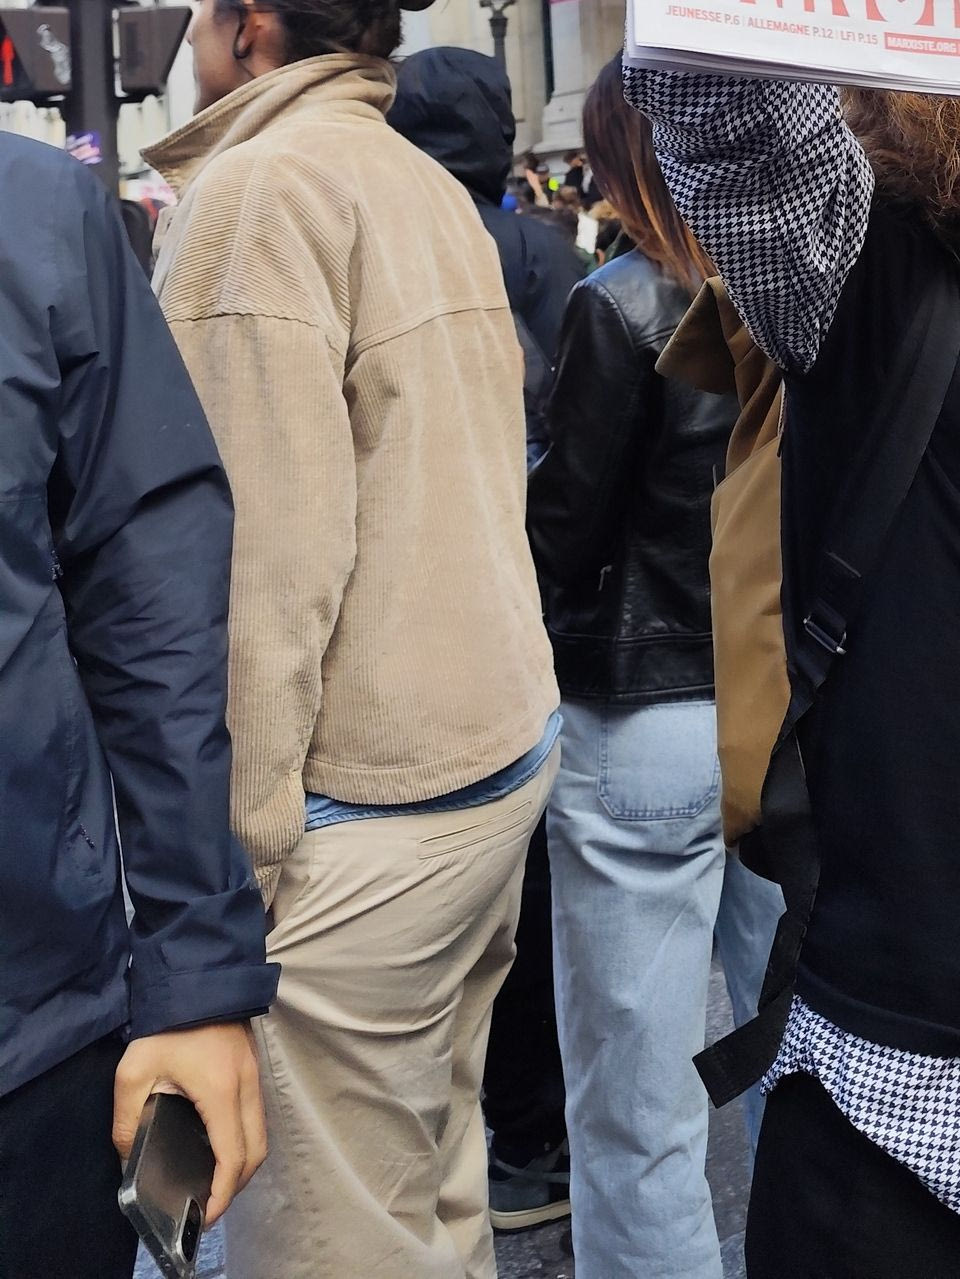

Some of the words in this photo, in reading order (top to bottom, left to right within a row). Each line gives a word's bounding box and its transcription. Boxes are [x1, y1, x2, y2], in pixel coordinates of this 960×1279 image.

[665, 5, 722, 23] JEUNESSE
[724, 14, 741, 26] P.6
[747, 17, 810, 36] ALLEMAGNE
[812, 26, 833, 39] P.12
[840, 30, 856, 42] LFI
[858, 32, 878, 45] P.15
